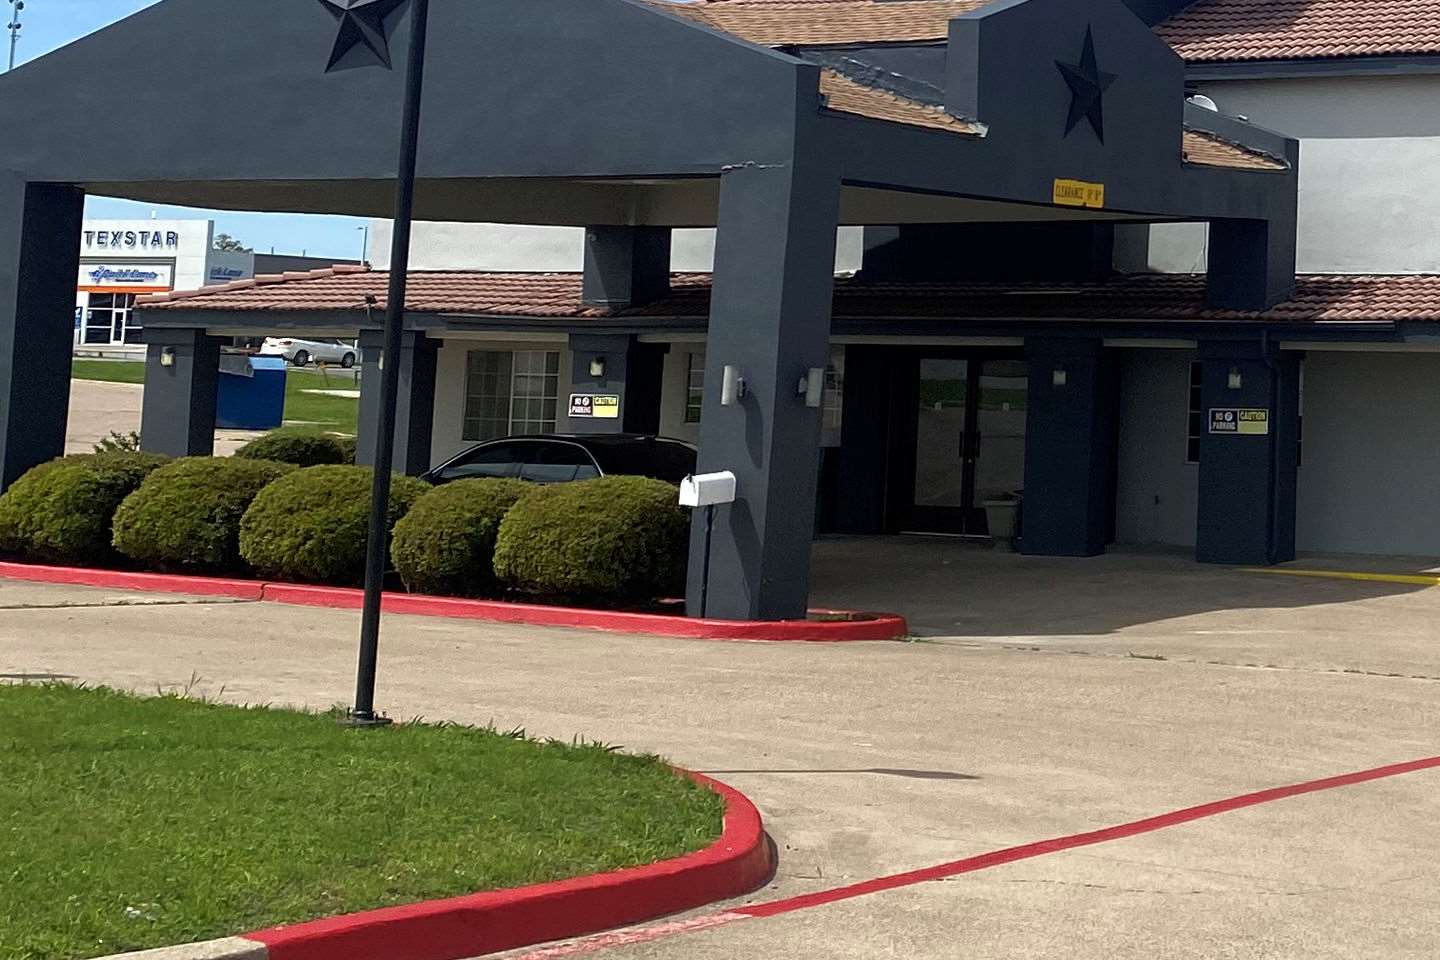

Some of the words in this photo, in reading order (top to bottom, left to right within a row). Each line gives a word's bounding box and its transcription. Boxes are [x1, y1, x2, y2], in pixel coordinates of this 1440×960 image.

[84, 230, 178, 248] TEXSTAR
[594, 396, 617, 406] CAUTION
[1215, 412, 1224, 421] NO
[1240, 410, 1266, 420] CAUTION
[1212, 421, 1236, 430] PARKING
